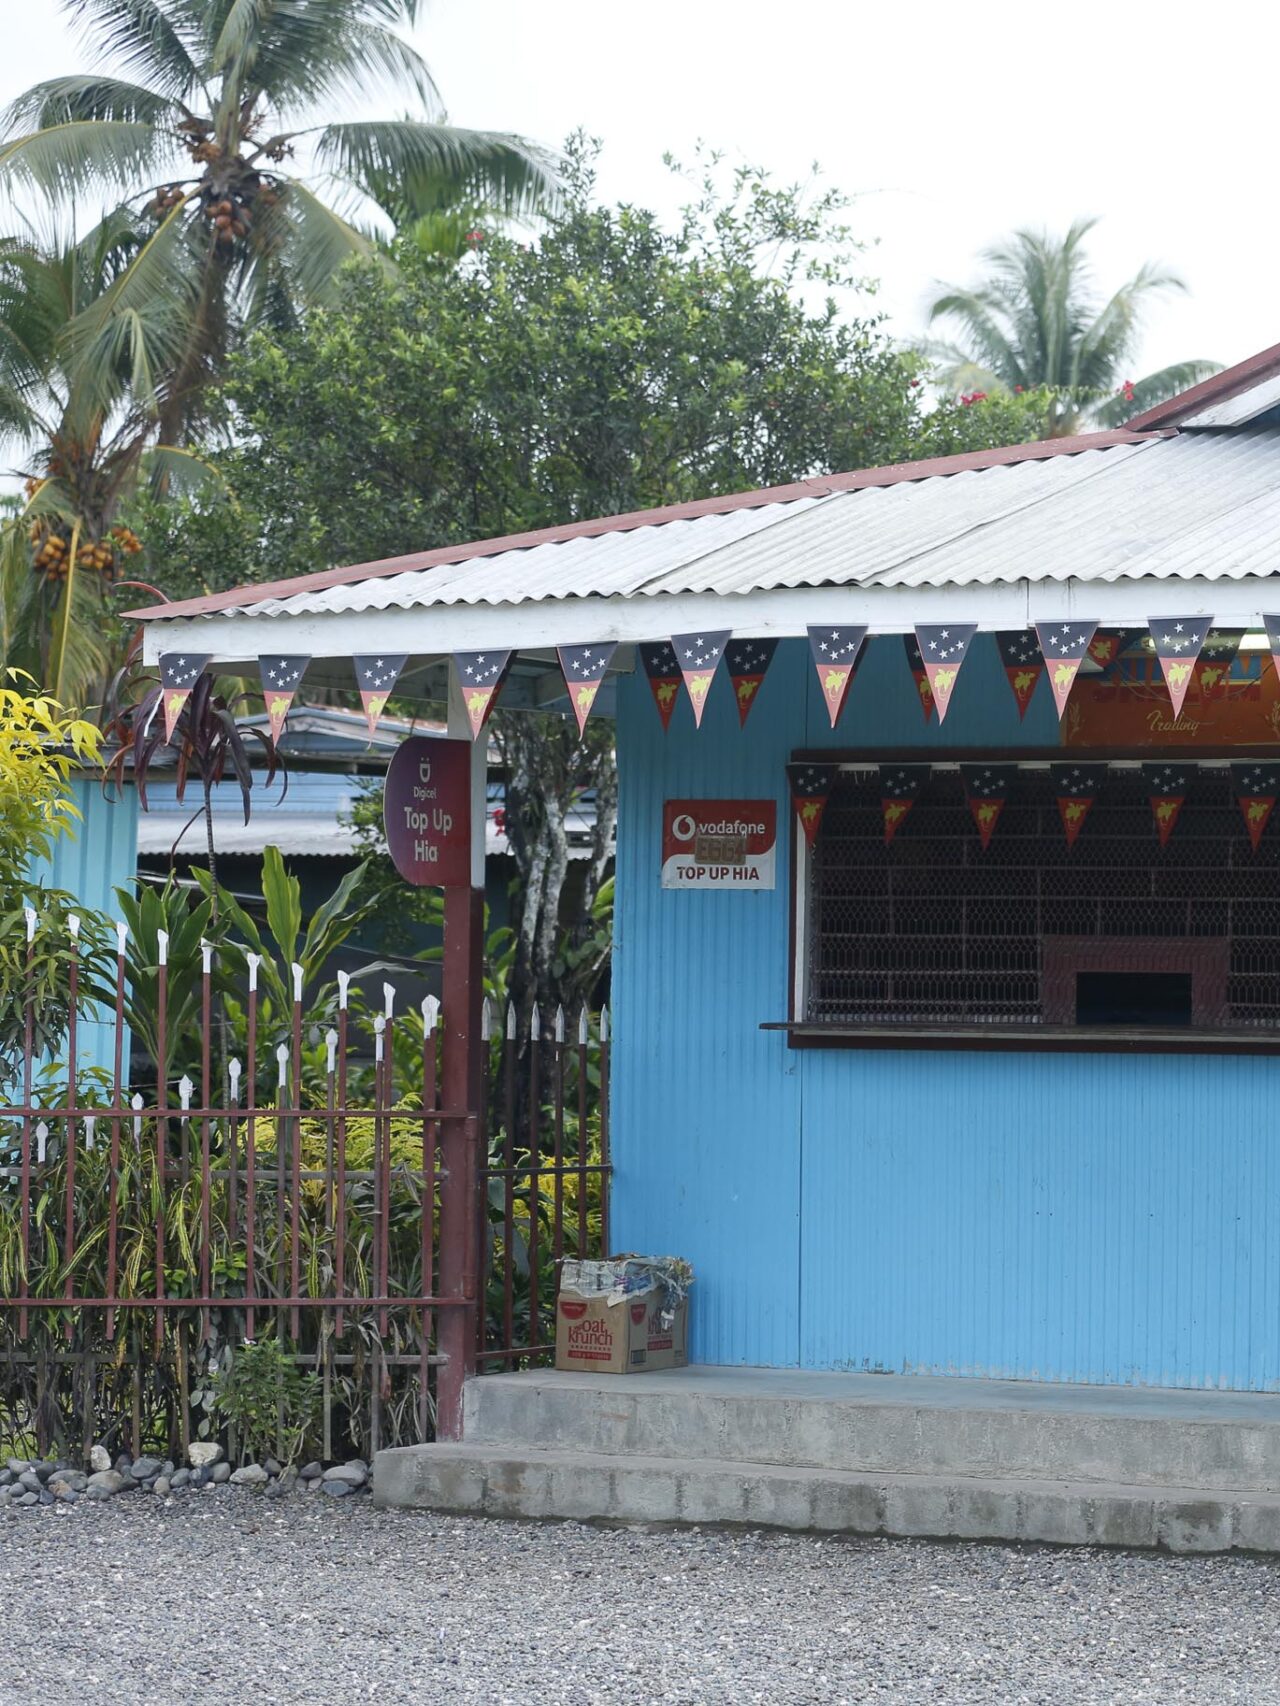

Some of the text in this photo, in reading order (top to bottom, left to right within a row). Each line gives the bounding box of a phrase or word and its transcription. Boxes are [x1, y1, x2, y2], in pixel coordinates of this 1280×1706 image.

[1146, 709, 1200, 736] Trading
[413, 786, 437, 801] Digicel
[404, 807, 452, 836] Top Up
[698, 820, 766, 834] vodafone
[414, 839, 438, 862] Hia
[676, 866, 760, 880] TOP UP HIA
[582, 1318, 606, 1334] oat
[568, 1326, 613, 1346] krunch
